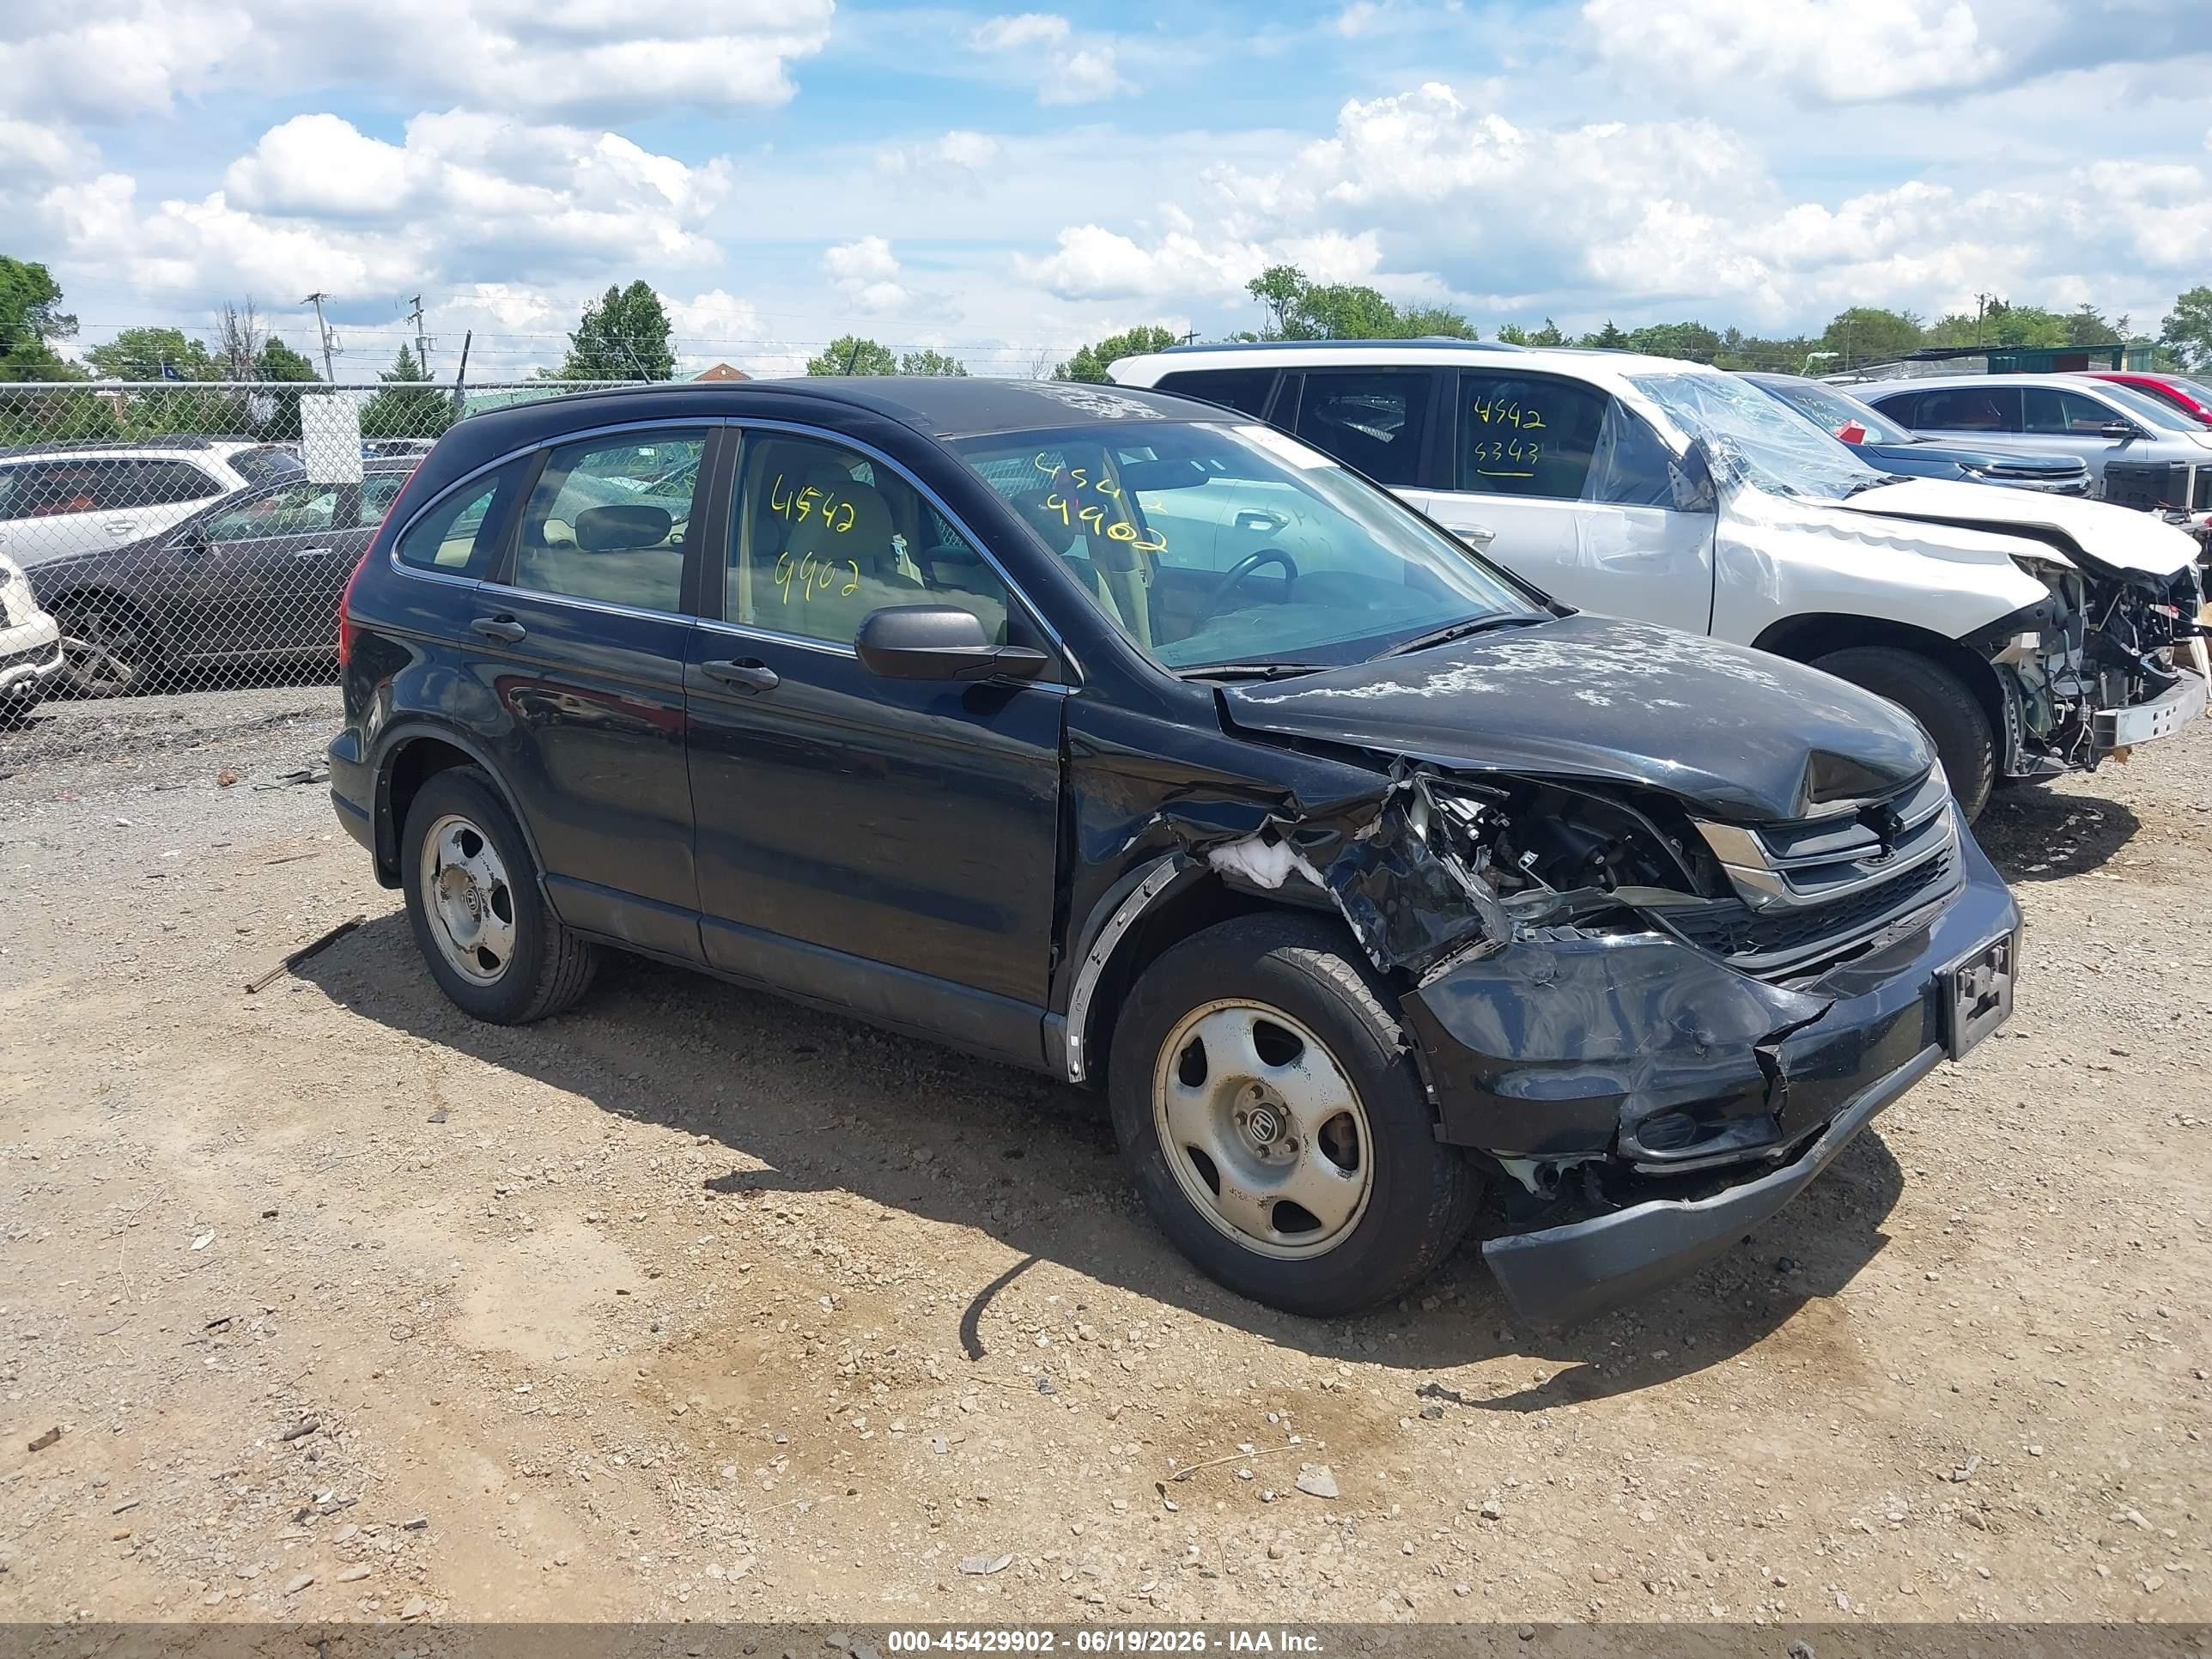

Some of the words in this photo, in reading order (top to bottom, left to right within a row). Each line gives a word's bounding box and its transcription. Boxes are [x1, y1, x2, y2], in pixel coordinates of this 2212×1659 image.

[1474, 395, 1547, 428] 4542
[1474, 437, 1539, 465] 5343
[771, 473, 855, 533] 4542
[1046, 493, 1169, 554] 9902
[775, 550, 860, 605] 9902
